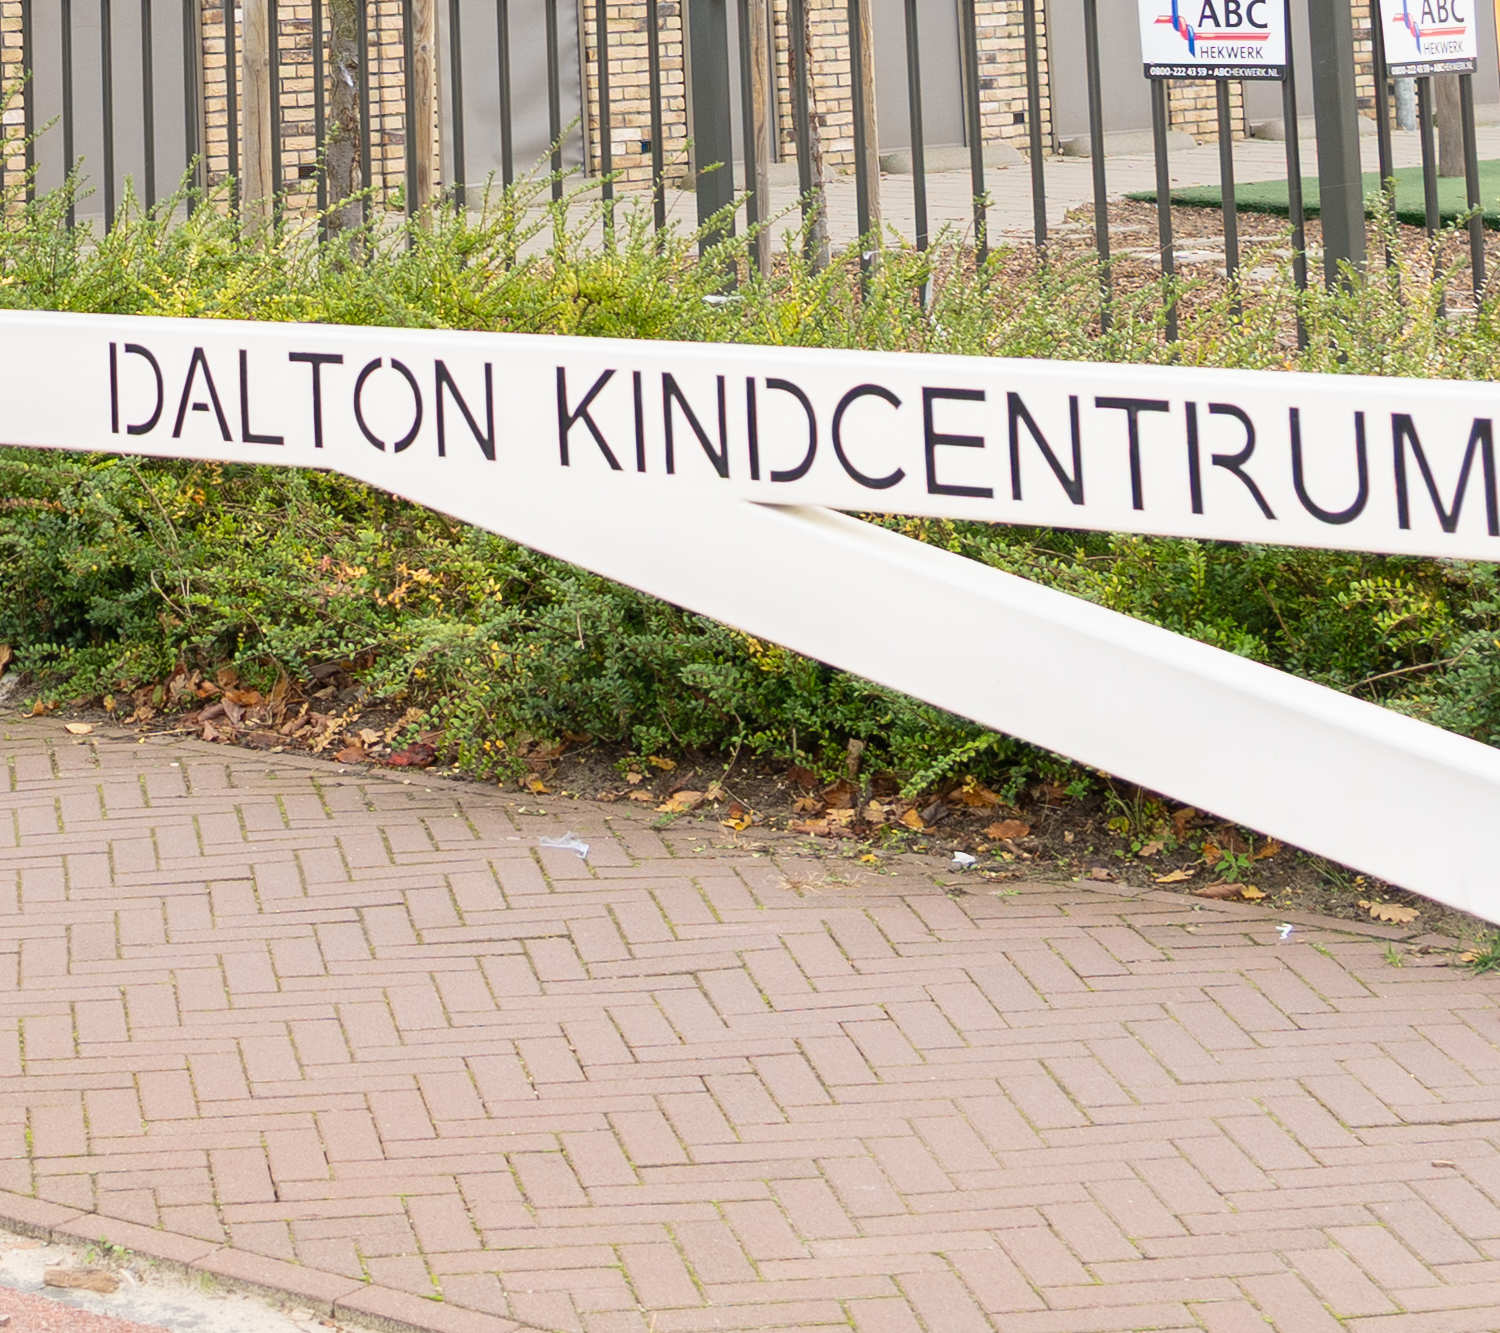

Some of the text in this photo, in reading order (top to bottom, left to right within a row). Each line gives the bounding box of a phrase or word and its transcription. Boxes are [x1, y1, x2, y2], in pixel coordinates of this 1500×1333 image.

[1200, 46, 1263, 59] HEKWERK
[1424, 41, 1464, 55] HEKWERK
[1150, 66, 1186, 77] 0800-222
[1197, 66, 1207, 77] 59
[109, 341, 496, 461] DALTON
